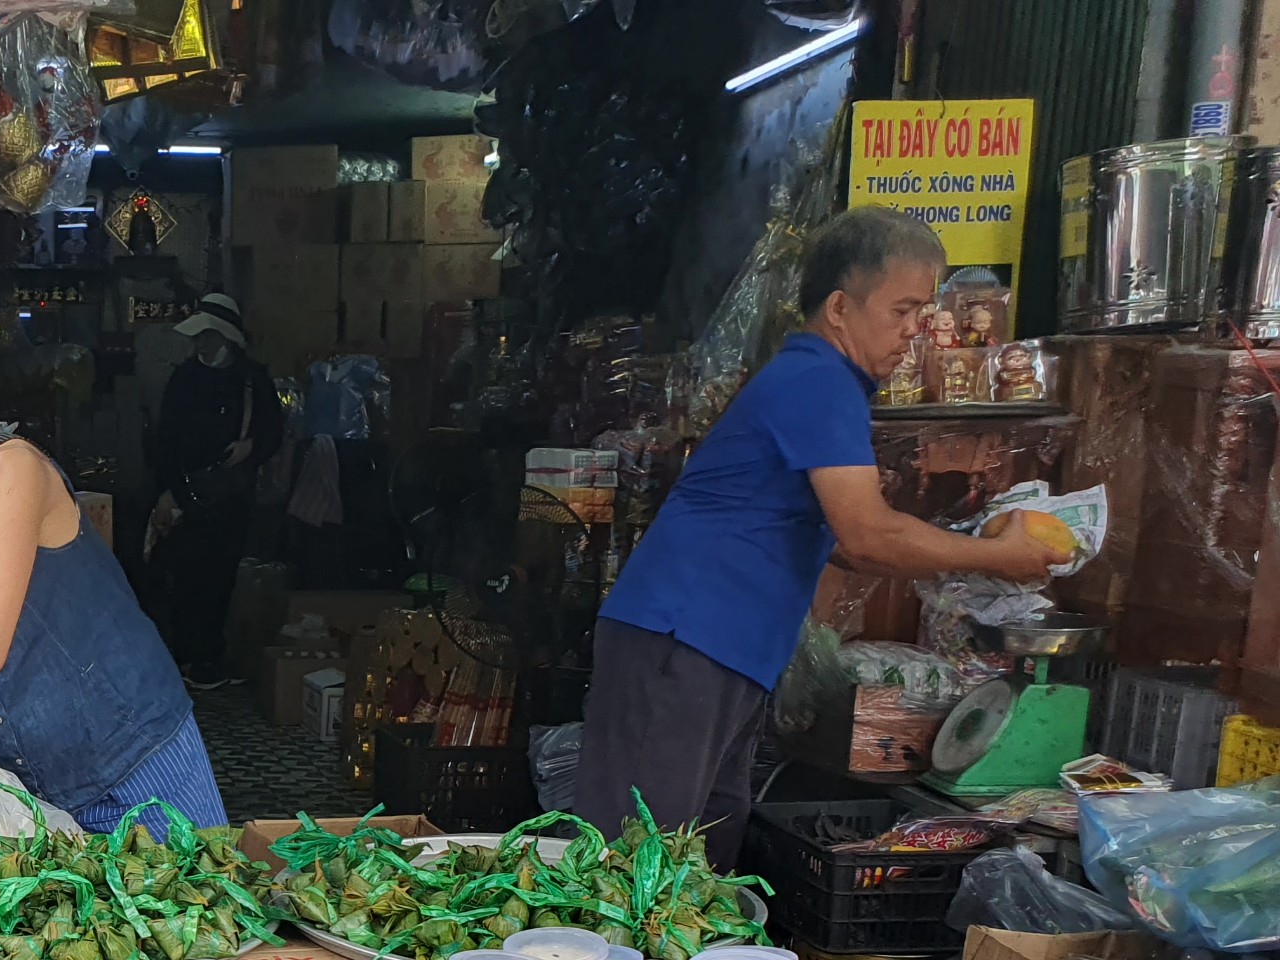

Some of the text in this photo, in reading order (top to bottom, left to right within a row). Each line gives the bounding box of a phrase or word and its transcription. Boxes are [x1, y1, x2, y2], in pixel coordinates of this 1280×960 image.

[862, 106, 1021, 167] TẠI ĐÂY CÓ BÁN
[867, 170, 1015, 193] THUỐC XÔNG NHÀ
[966, 205, 1012, 223] LONG
